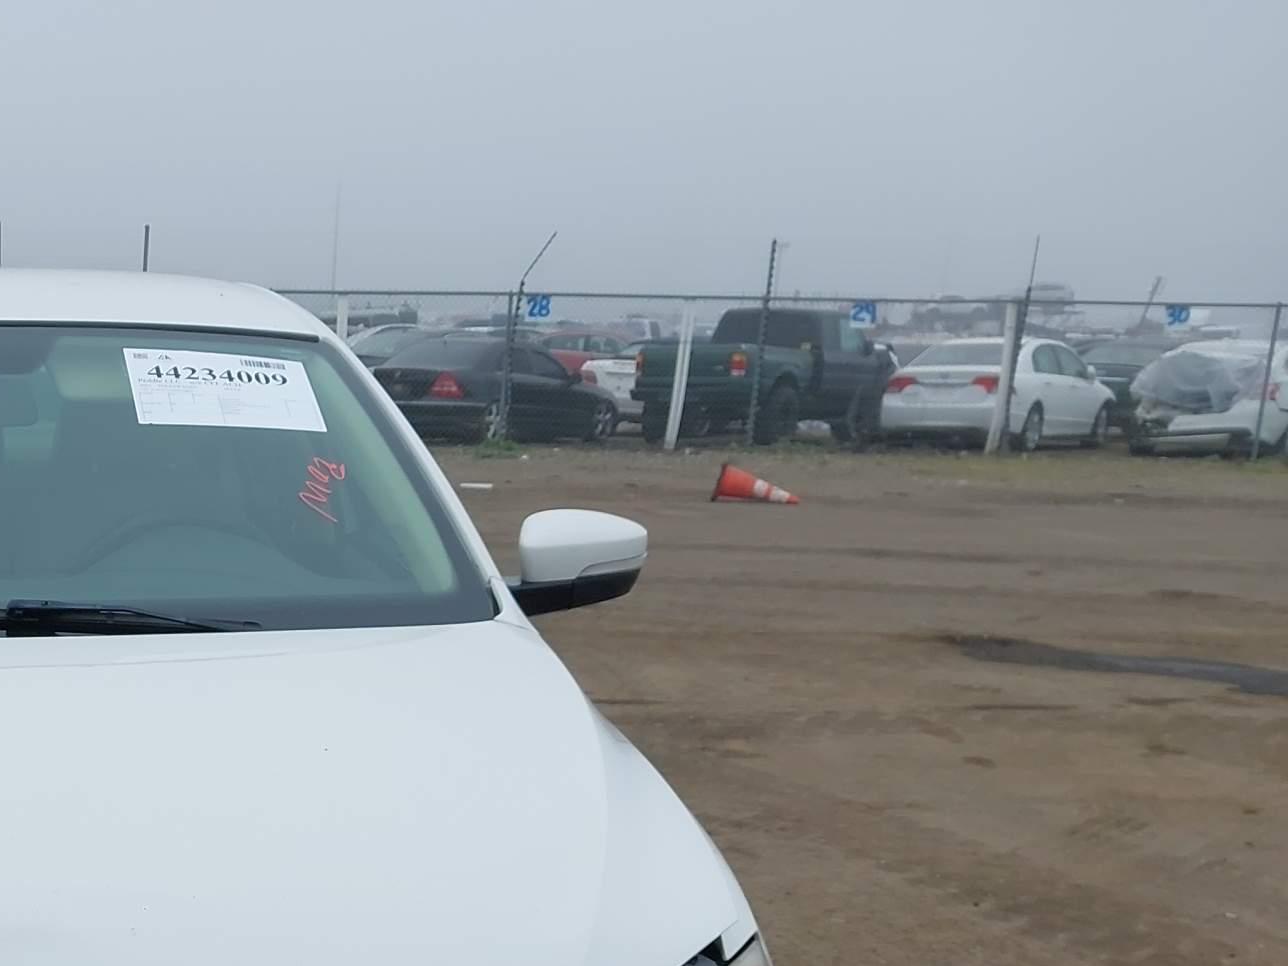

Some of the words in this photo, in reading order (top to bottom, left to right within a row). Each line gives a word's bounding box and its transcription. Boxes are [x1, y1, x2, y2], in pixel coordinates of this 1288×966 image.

[527, 295, 551, 317] 28
[852, 303, 876, 323] 29
[1166, 304, 1190, 326] 30
[147, 365, 288, 386] 44234009
